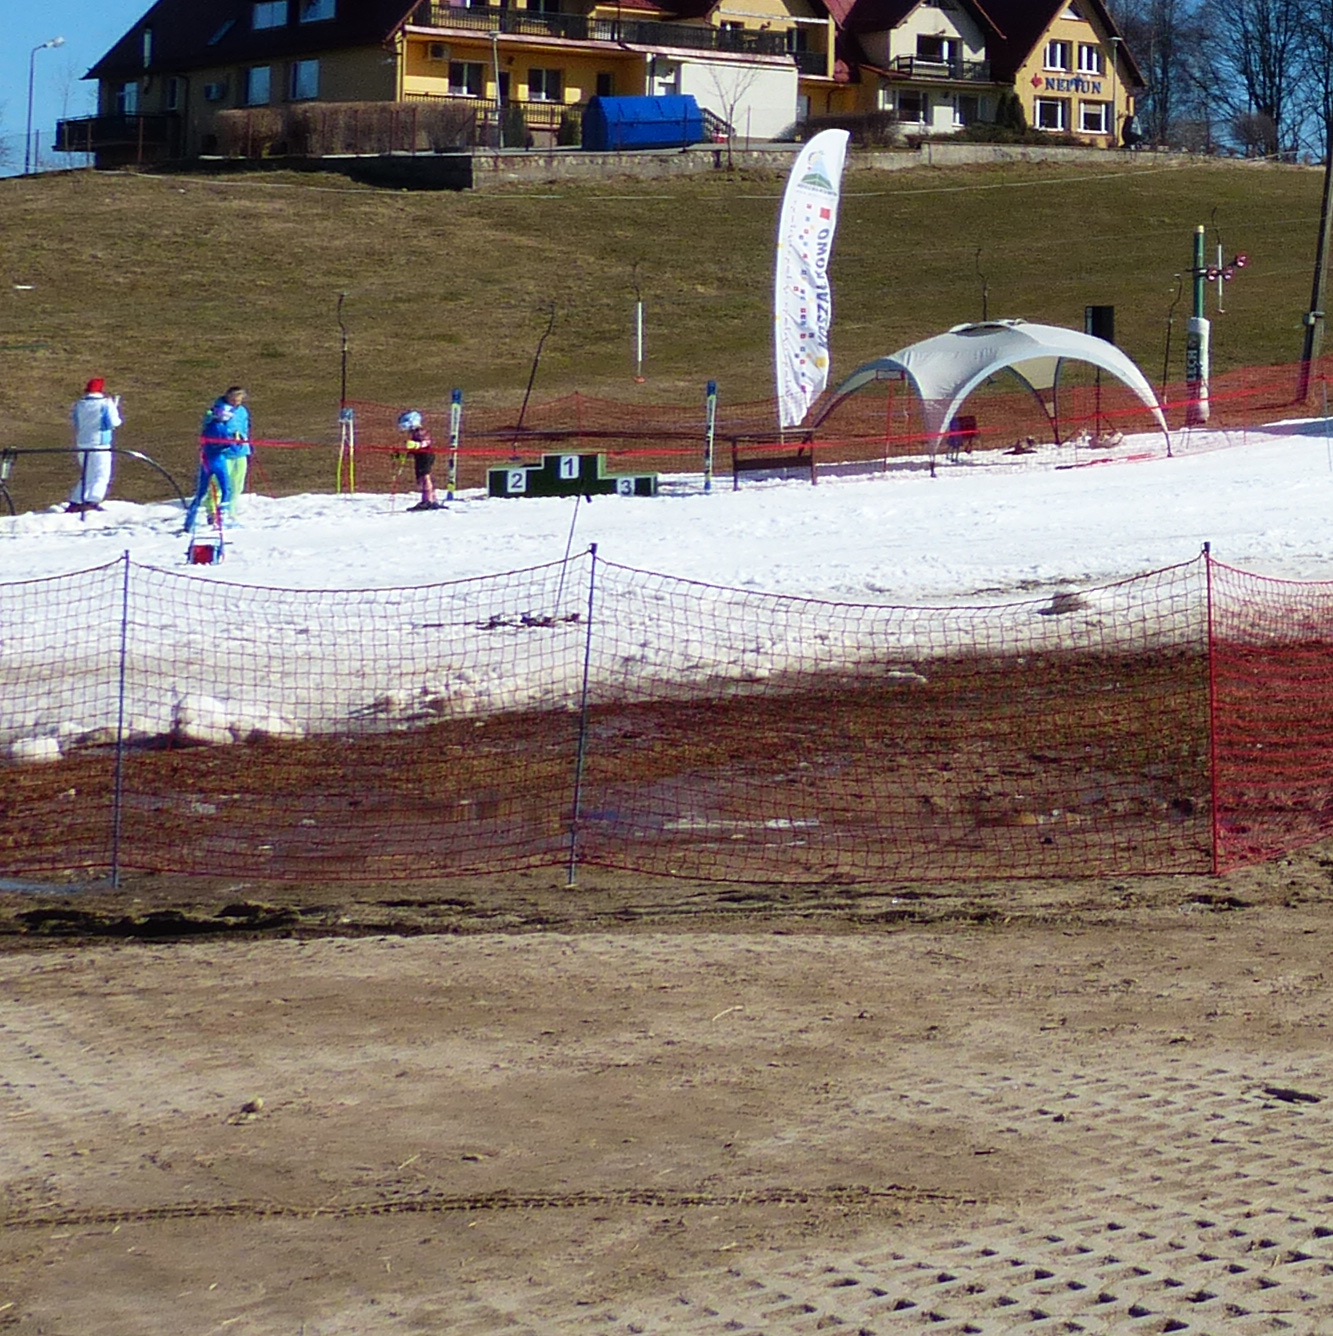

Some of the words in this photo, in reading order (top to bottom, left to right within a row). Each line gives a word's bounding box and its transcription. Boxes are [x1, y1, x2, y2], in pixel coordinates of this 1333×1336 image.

[814, 227, 831, 351] KOSZAŁKOWO
[563, 457, 573, 477] 1
[511, 472, 523, 489] 2
[620, 479, 632, 496] 3
